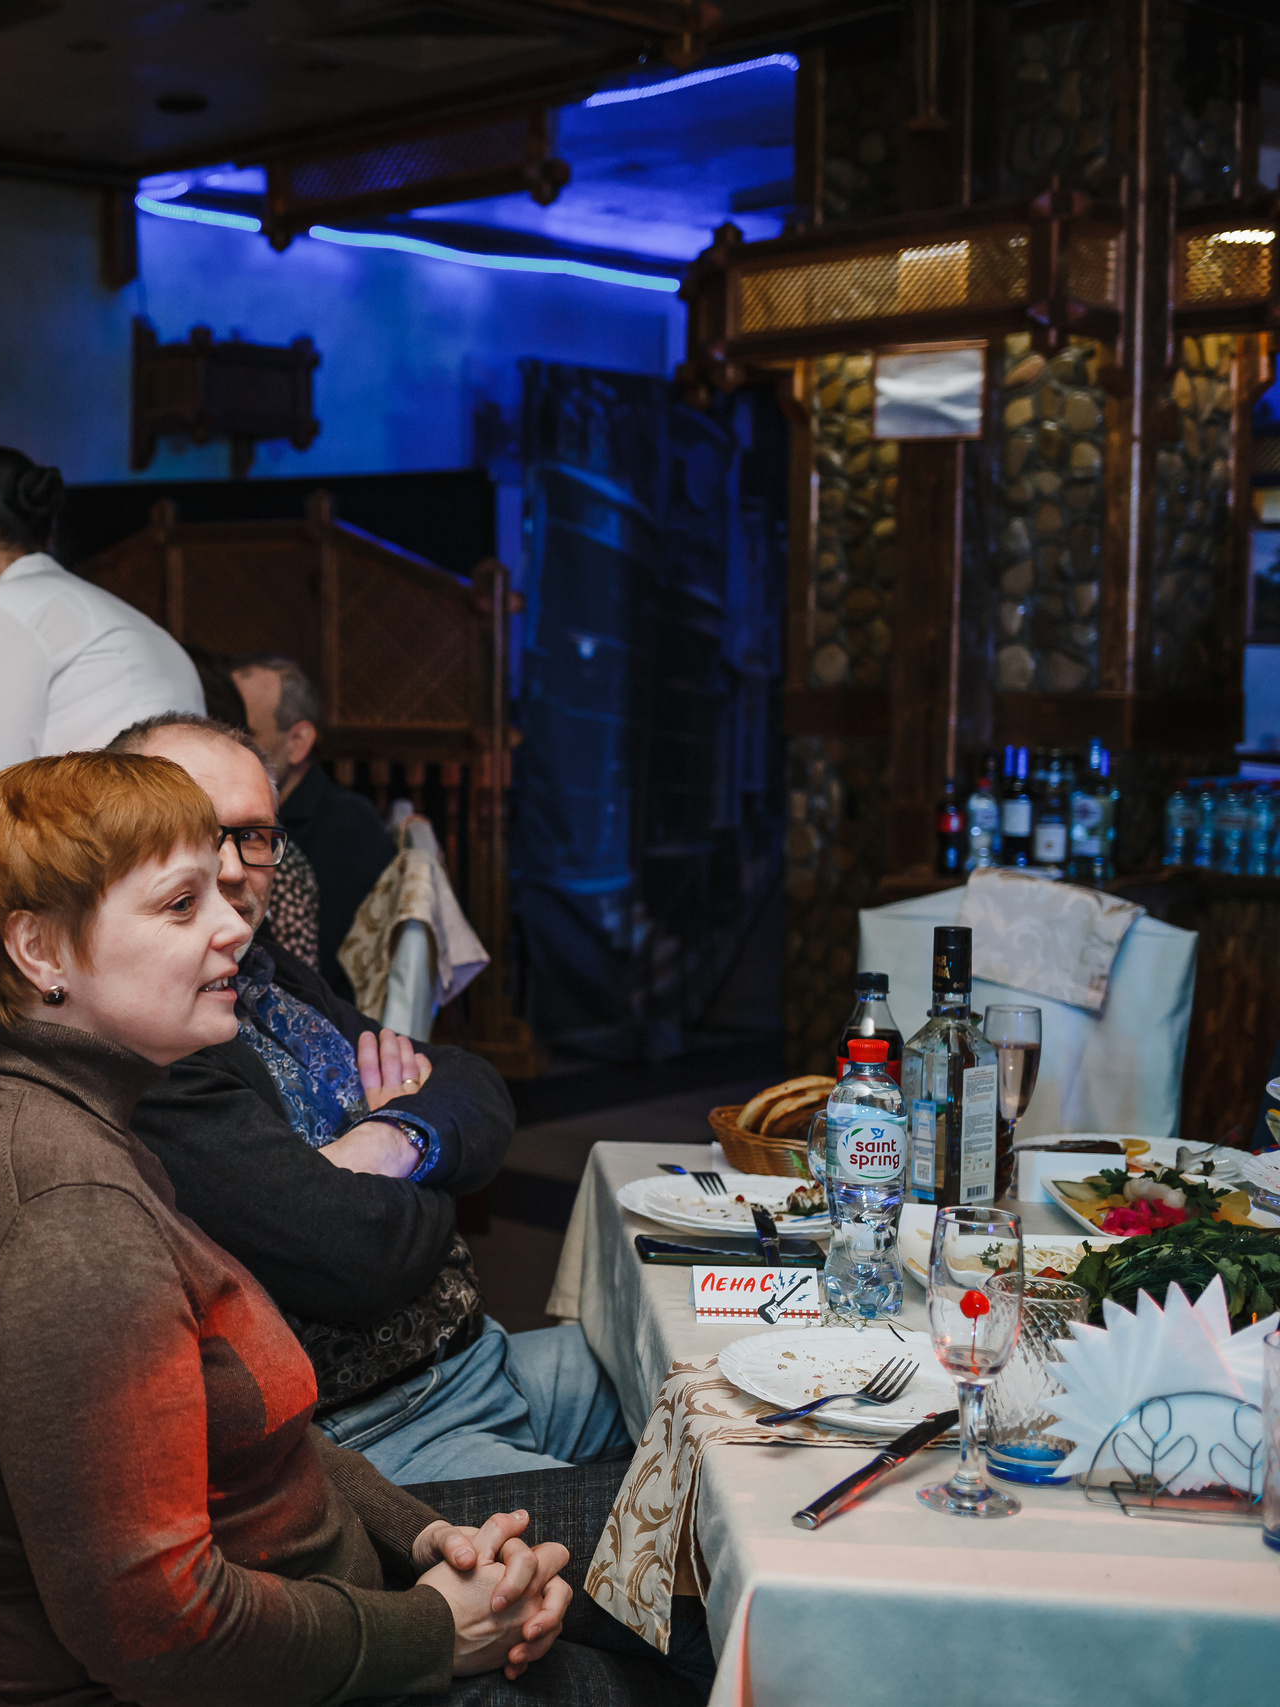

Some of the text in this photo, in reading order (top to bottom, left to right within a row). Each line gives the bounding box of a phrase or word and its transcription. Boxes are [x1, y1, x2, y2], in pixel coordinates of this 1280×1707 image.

[855, 1139, 897, 1153] saint
[849, 1153, 900, 1170] spring
[700, 1272, 756, 1293] ЛЕНА
